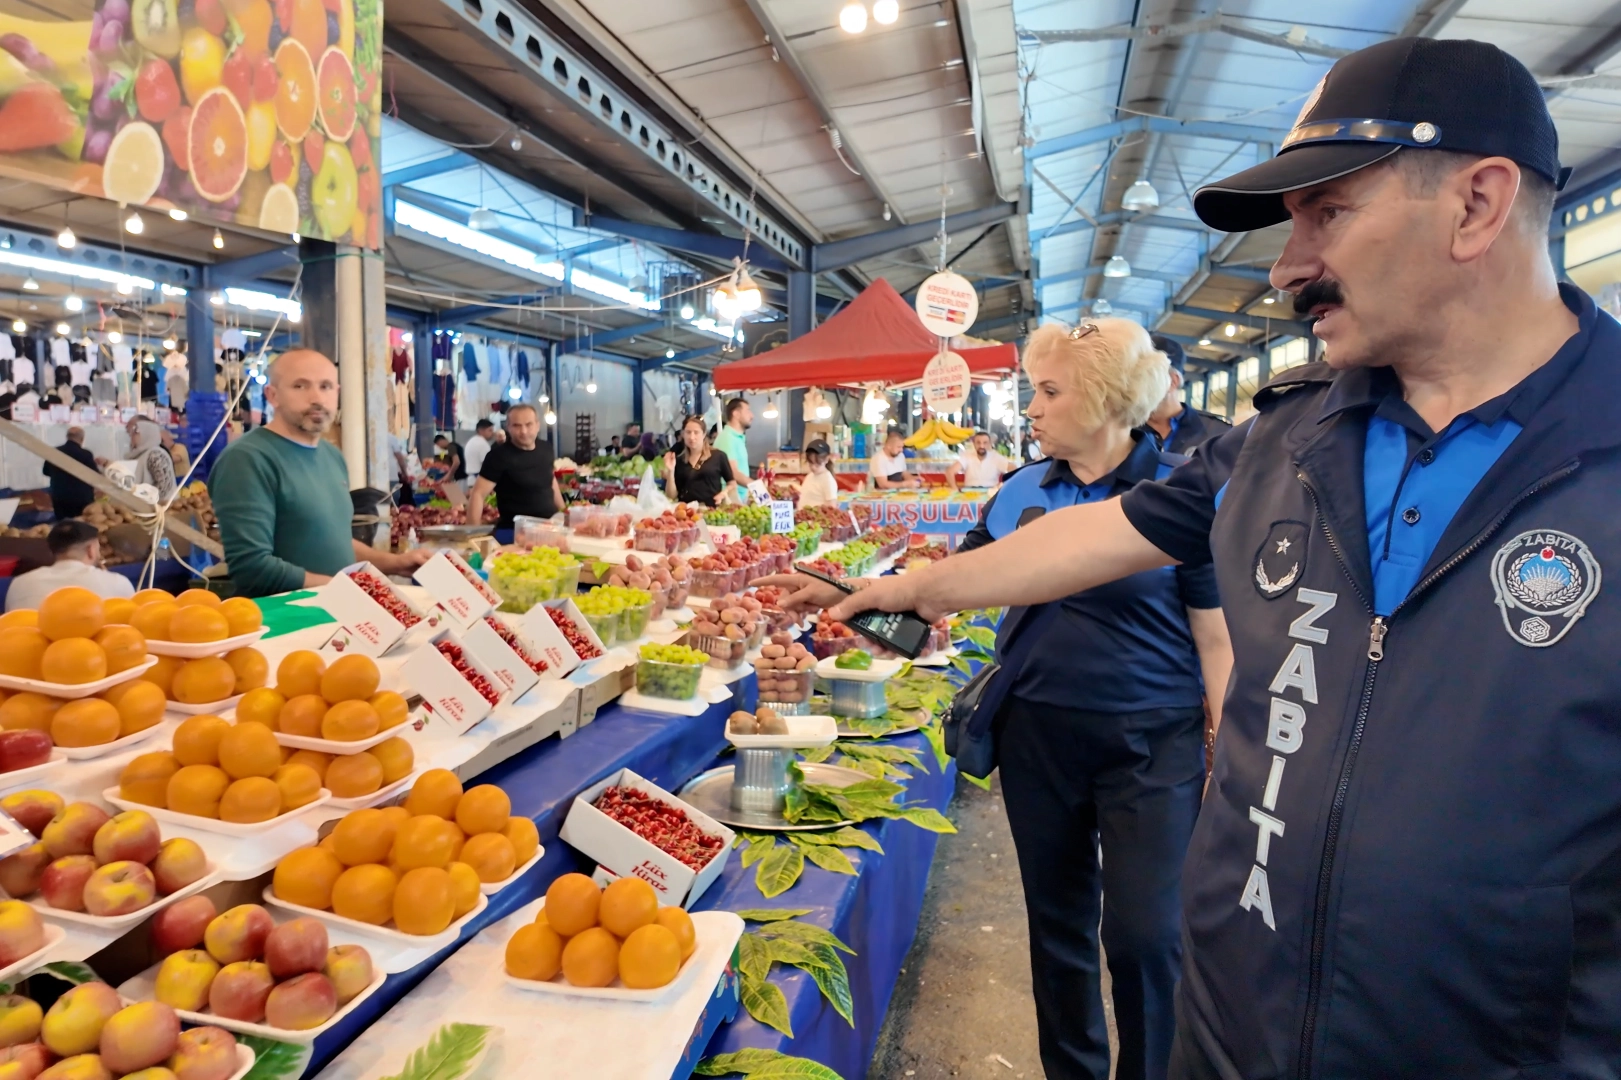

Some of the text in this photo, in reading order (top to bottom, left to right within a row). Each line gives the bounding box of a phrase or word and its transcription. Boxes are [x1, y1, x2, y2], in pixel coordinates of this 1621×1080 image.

[1523, 534, 1576, 554] ZABITA
[1239, 587, 1337, 932] ZABITA
[631, 865, 668, 894] Kiraz
[641, 860, 668, 880] Lüx
